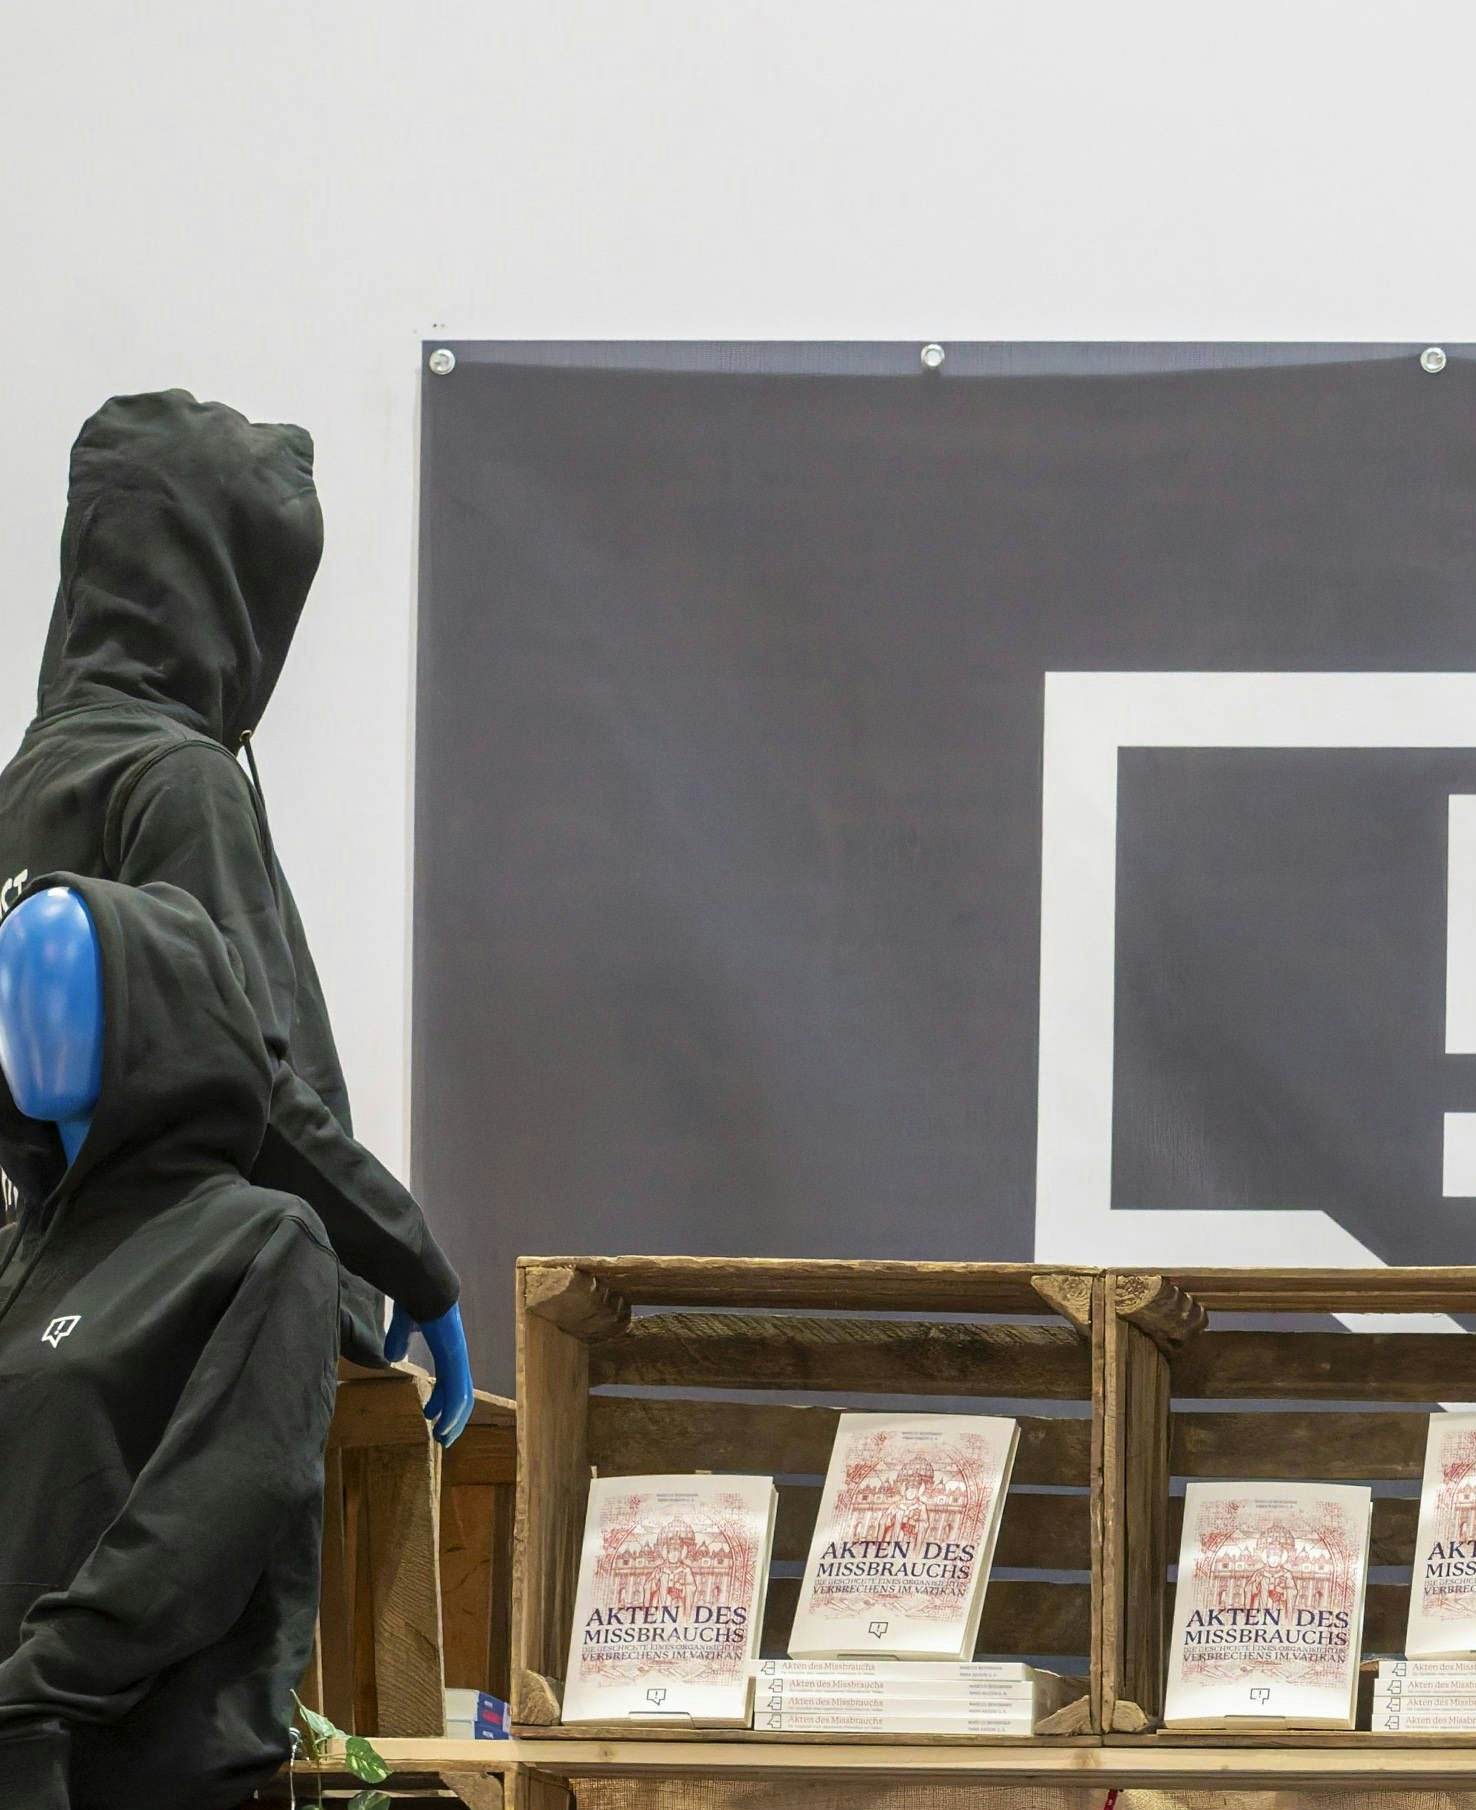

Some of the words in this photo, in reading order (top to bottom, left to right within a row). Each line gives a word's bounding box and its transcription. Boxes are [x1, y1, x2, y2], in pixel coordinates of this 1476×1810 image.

[821, 1541, 915, 1560] AKTEN
[921, 1542, 974, 1562] DES
[817, 1561, 970, 1579] MISSBRAUCHS
[586, 1606, 679, 1626] AKTEN
[694, 1606, 746, 1625] DES
[1185, 1609, 1280, 1628] AKTEN
[1297, 1608, 1349, 1628] DES
[583, 1627, 744, 1645] MISSBRAUCHS
[1185, 1629, 1346, 1646] MISSBRAUCHS
[1184, 1653, 1270, 1663] VERBRECHENS
[1275, 1653, 1289, 1662] IM
[1292, 1653, 1346, 1663] VATIKAN
